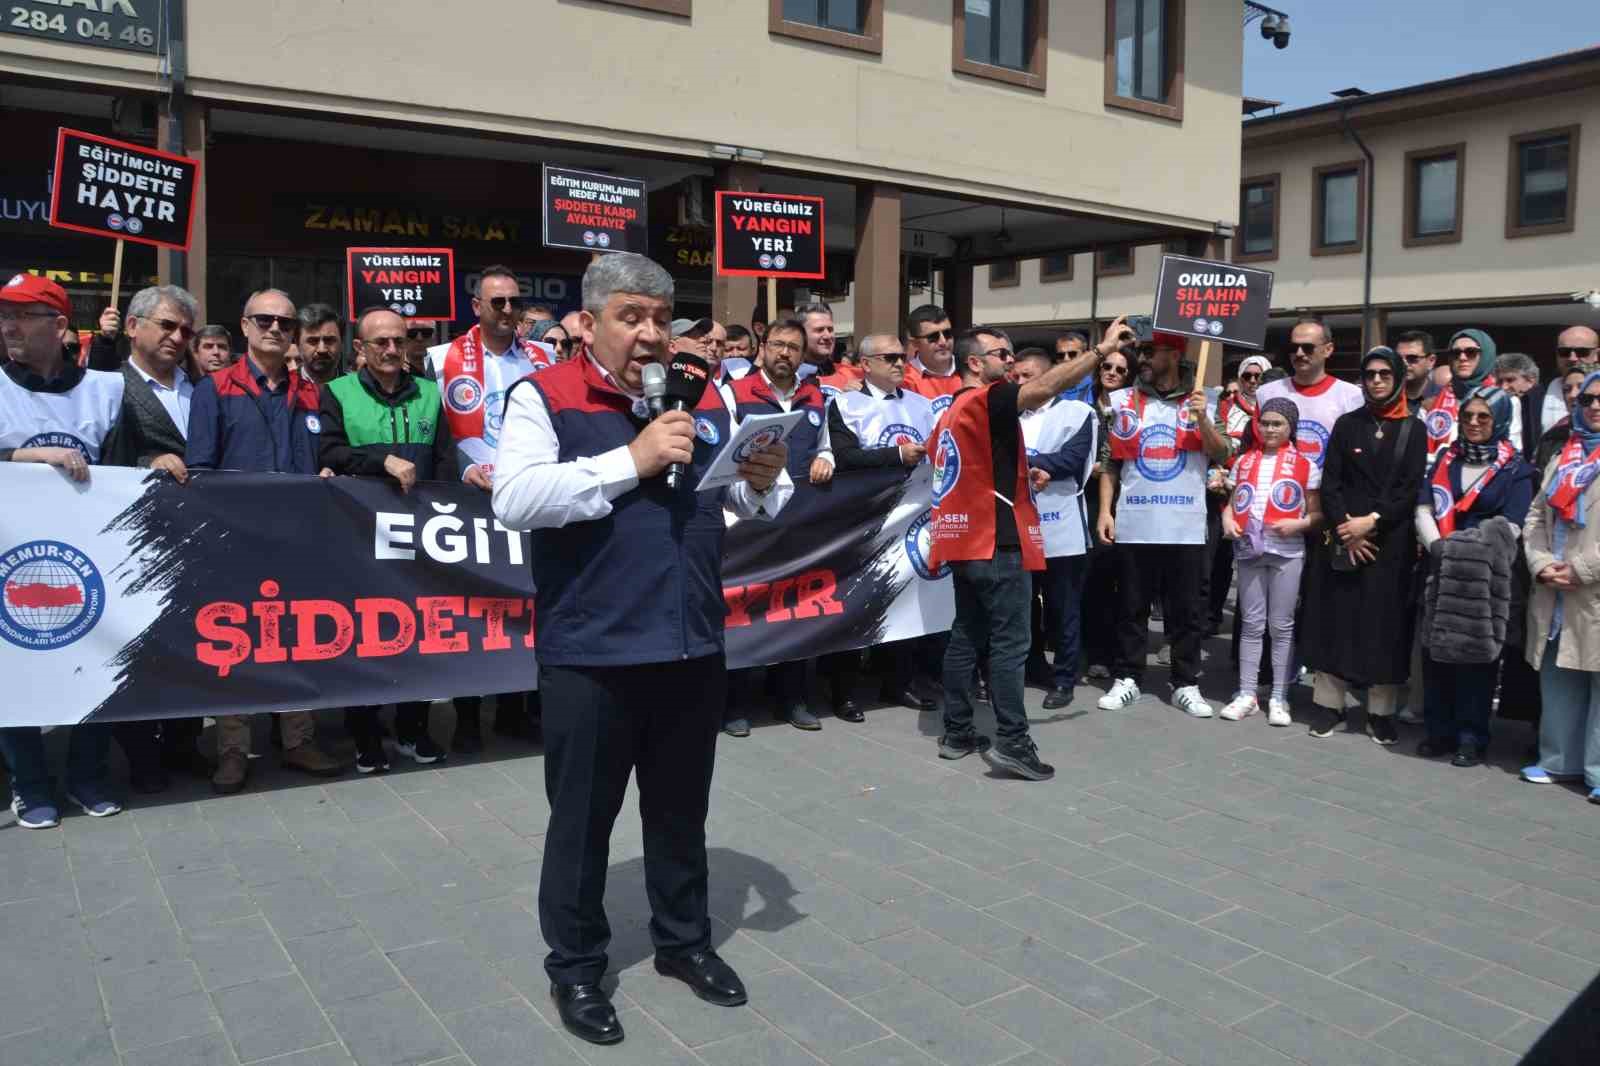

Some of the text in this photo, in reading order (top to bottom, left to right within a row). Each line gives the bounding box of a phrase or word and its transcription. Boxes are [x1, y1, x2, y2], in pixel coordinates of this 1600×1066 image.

[10, 7, 67, 34] 284
[77, 18, 113, 41] 04
[119, 25, 154, 47] 46
[79, 144, 184, 180] EĞİTİMCİYE
[82, 162, 177, 197] ŞİDDETE
[77, 182, 176, 223] HAYIR
[568, 188, 624, 205] HEDEF ALAN
[732, 198, 814, 216] YÜREĞİMİZ
[304, 204, 432, 238] ZAMAN
[566, 213, 626, 230] AYAKTAYIZ
[731, 215, 813, 235] YANGIN
[751, 235, 794, 253] YERİ
[362, 254, 442, 267] YÜREĞİMİZ
[361, 270, 441, 285] YANGIN
[1177, 273, 1248, 287] OKULDA
[381, 284, 423, 301] YERİ
[1207, 303, 1241, 317] NE?
[374, 500, 532, 565] EĞİT
[723, 569, 844, 628] YIR
[195, 579, 534, 677] ŞİDDET
